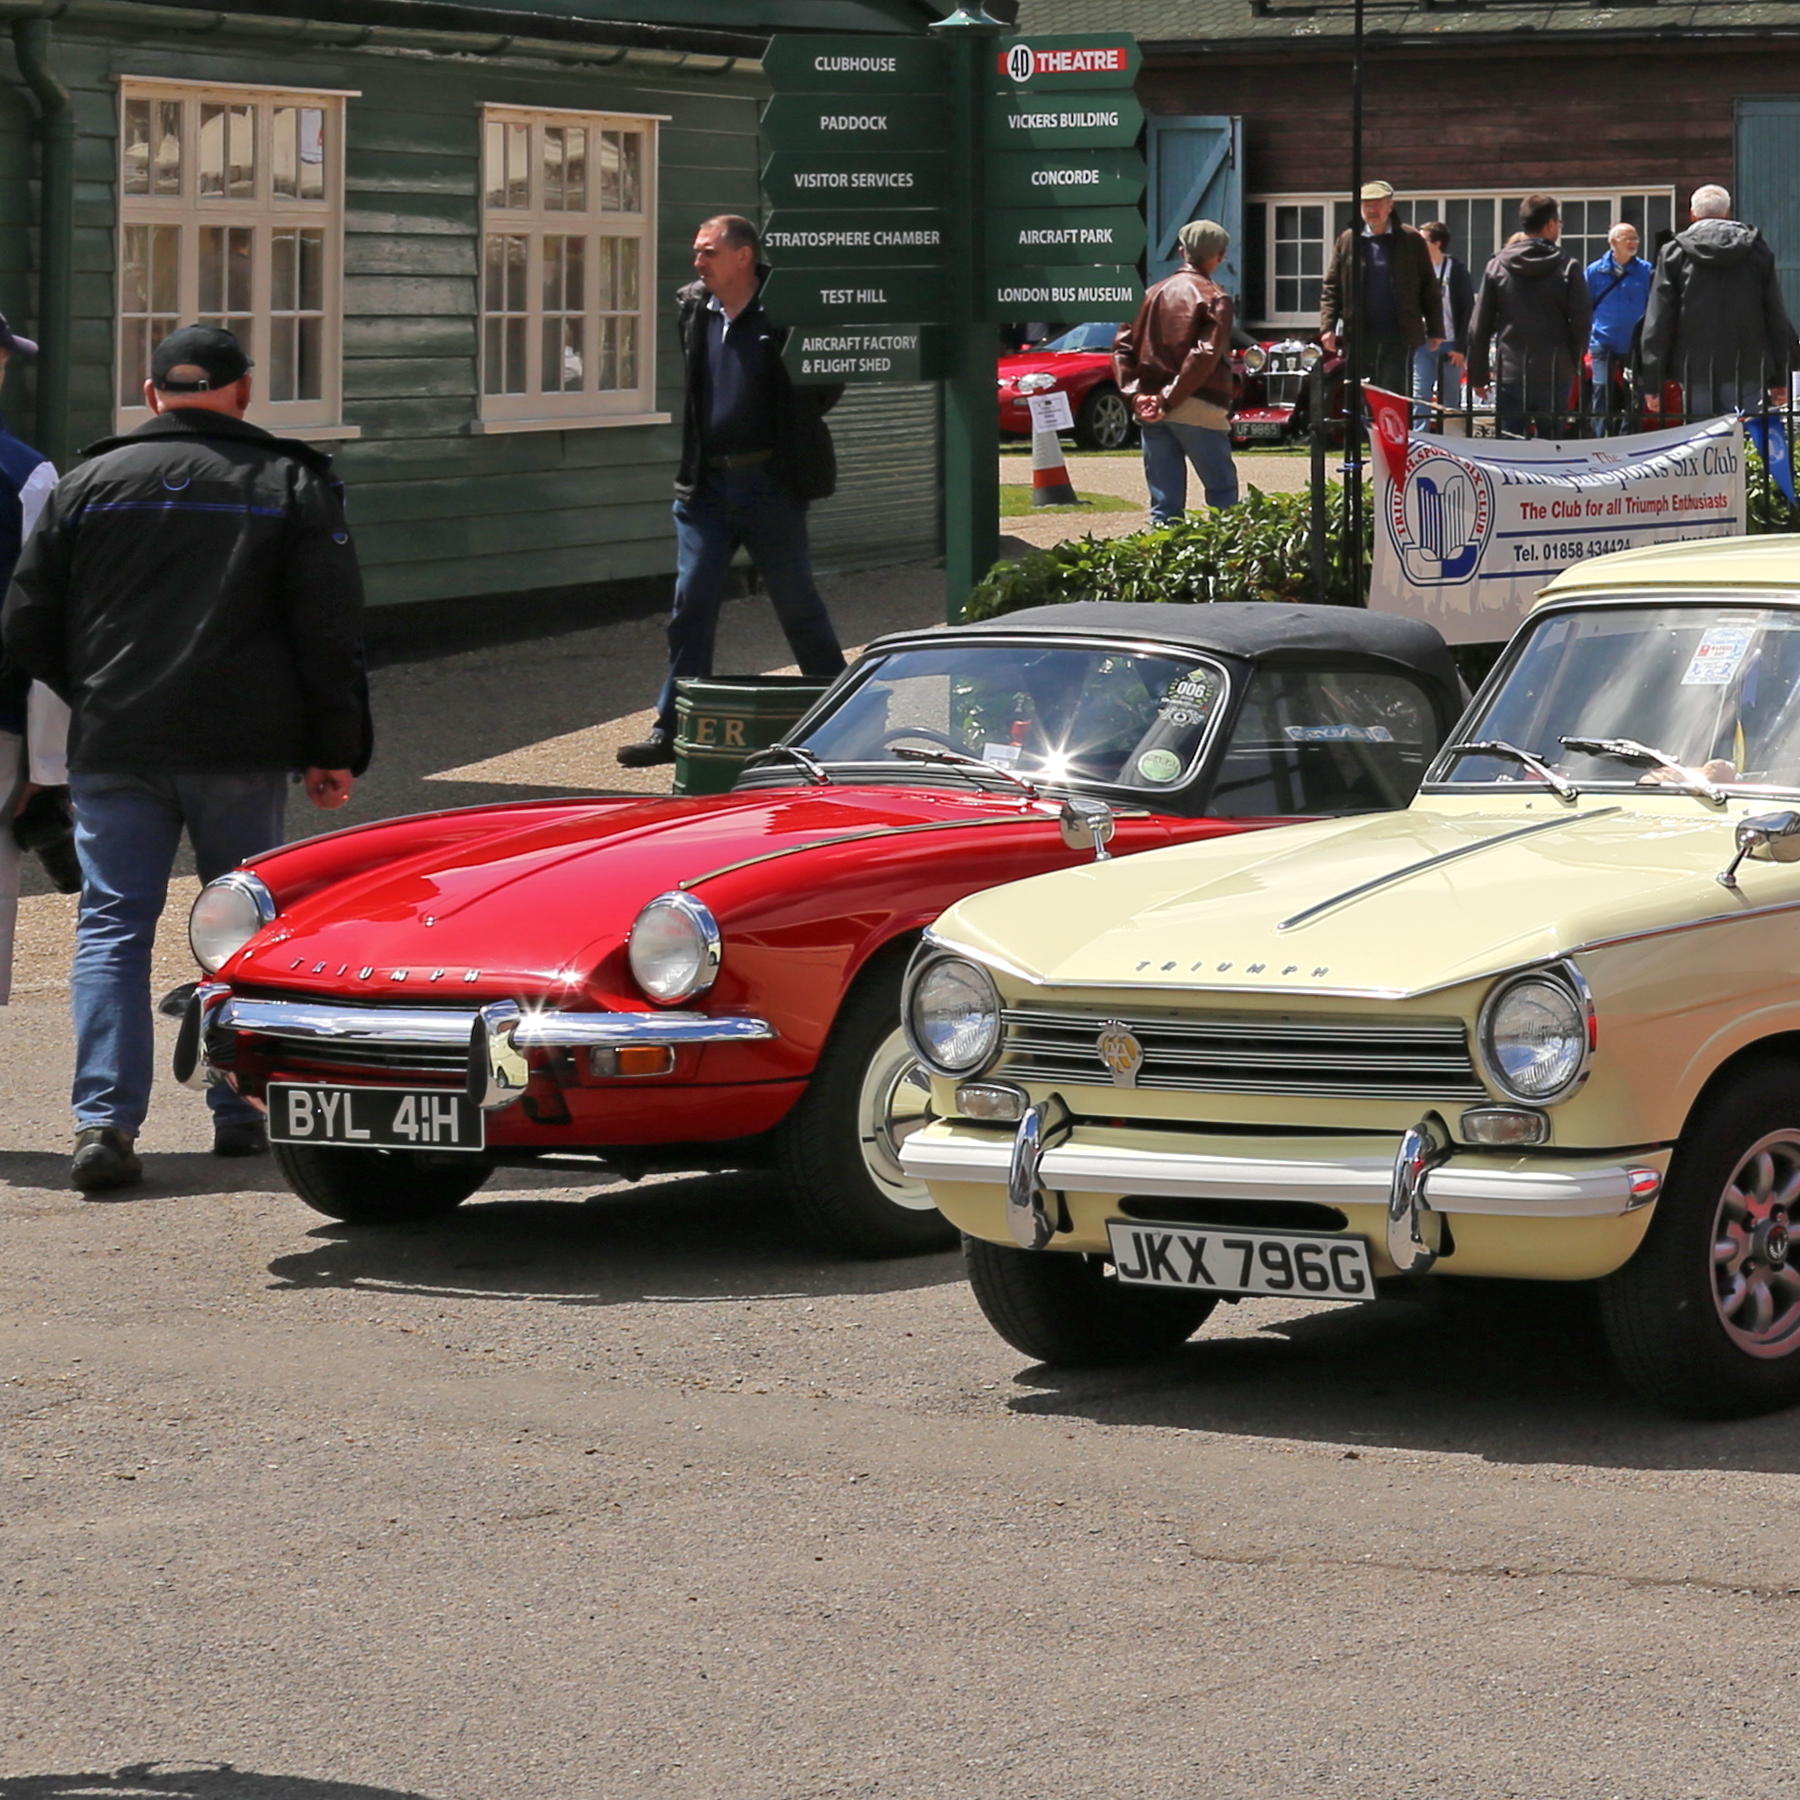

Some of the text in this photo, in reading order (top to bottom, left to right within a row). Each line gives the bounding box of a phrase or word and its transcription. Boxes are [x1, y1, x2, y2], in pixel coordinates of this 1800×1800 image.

[814, 56, 897, 72] CLUBHOUSE
[1010, 48, 1120, 78] 4D THEATRE
[820, 115, 888, 130] PADDOCK
[1007, 111, 1119, 129] VICKERS BUILDING
[793, 172, 914, 188] VISITOR SERVICES
[1030, 169, 1100, 185] CONCORDE
[765, 230, 941, 247] STRATOSPHERE CHAMBER
[1018, 228, 1113, 245] AIRCRAFT PARK
[819, 288, 887, 304] TEST HILL
[997, 287, 1133, 302] LONDON BUS MUSEUM
[801, 335, 918, 351] AIRCRAFT FACTORY
[801, 357, 891, 373] & FLIGHT SHED
[1592, 451, 1622, 465] The
[1668, 452, 1699, 478] Six
[1702, 446, 1738, 476] Club
[1463, 461, 1483, 487] SIX
[1475, 489, 1488, 535] CLUB
[1519, 492, 1728, 520] The Club for all Triumph Enthusiasts
[1513, 544, 1539, 562] Tel.
[1543, 541, 1583, 560] 01858
[289, 956, 482, 984] TRIUMPH
[1135, 960, 1331, 978] TRIUMPH
[288, 1089, 371, 1140] BYL
[1118, 1230, 1366, 1294] JKX 796G
